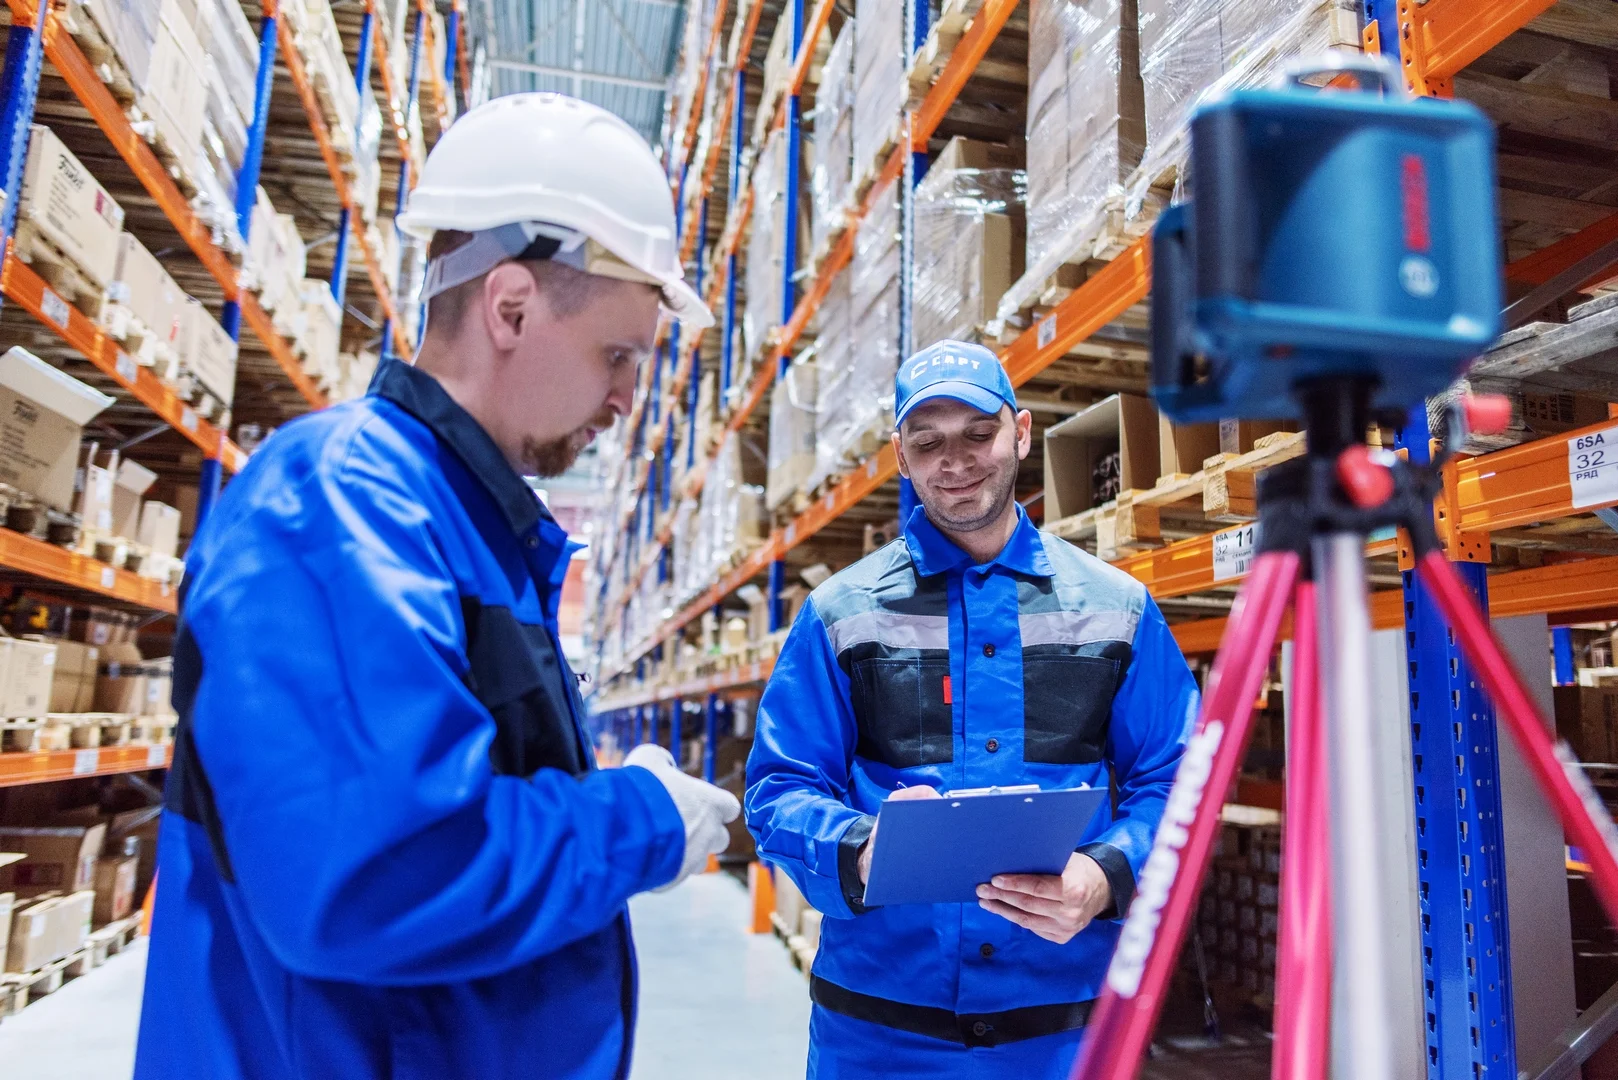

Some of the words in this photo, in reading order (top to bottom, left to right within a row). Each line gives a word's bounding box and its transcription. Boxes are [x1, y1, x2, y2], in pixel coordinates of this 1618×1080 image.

[1576, 433, 1605, 450] 6SA
[1576, 450, 1605, 469] 32
[1576, 469, 1598, 481] РЯД
[1236, 527, 1253, 547] 11
[1215, 544, 1228, 556] 32
